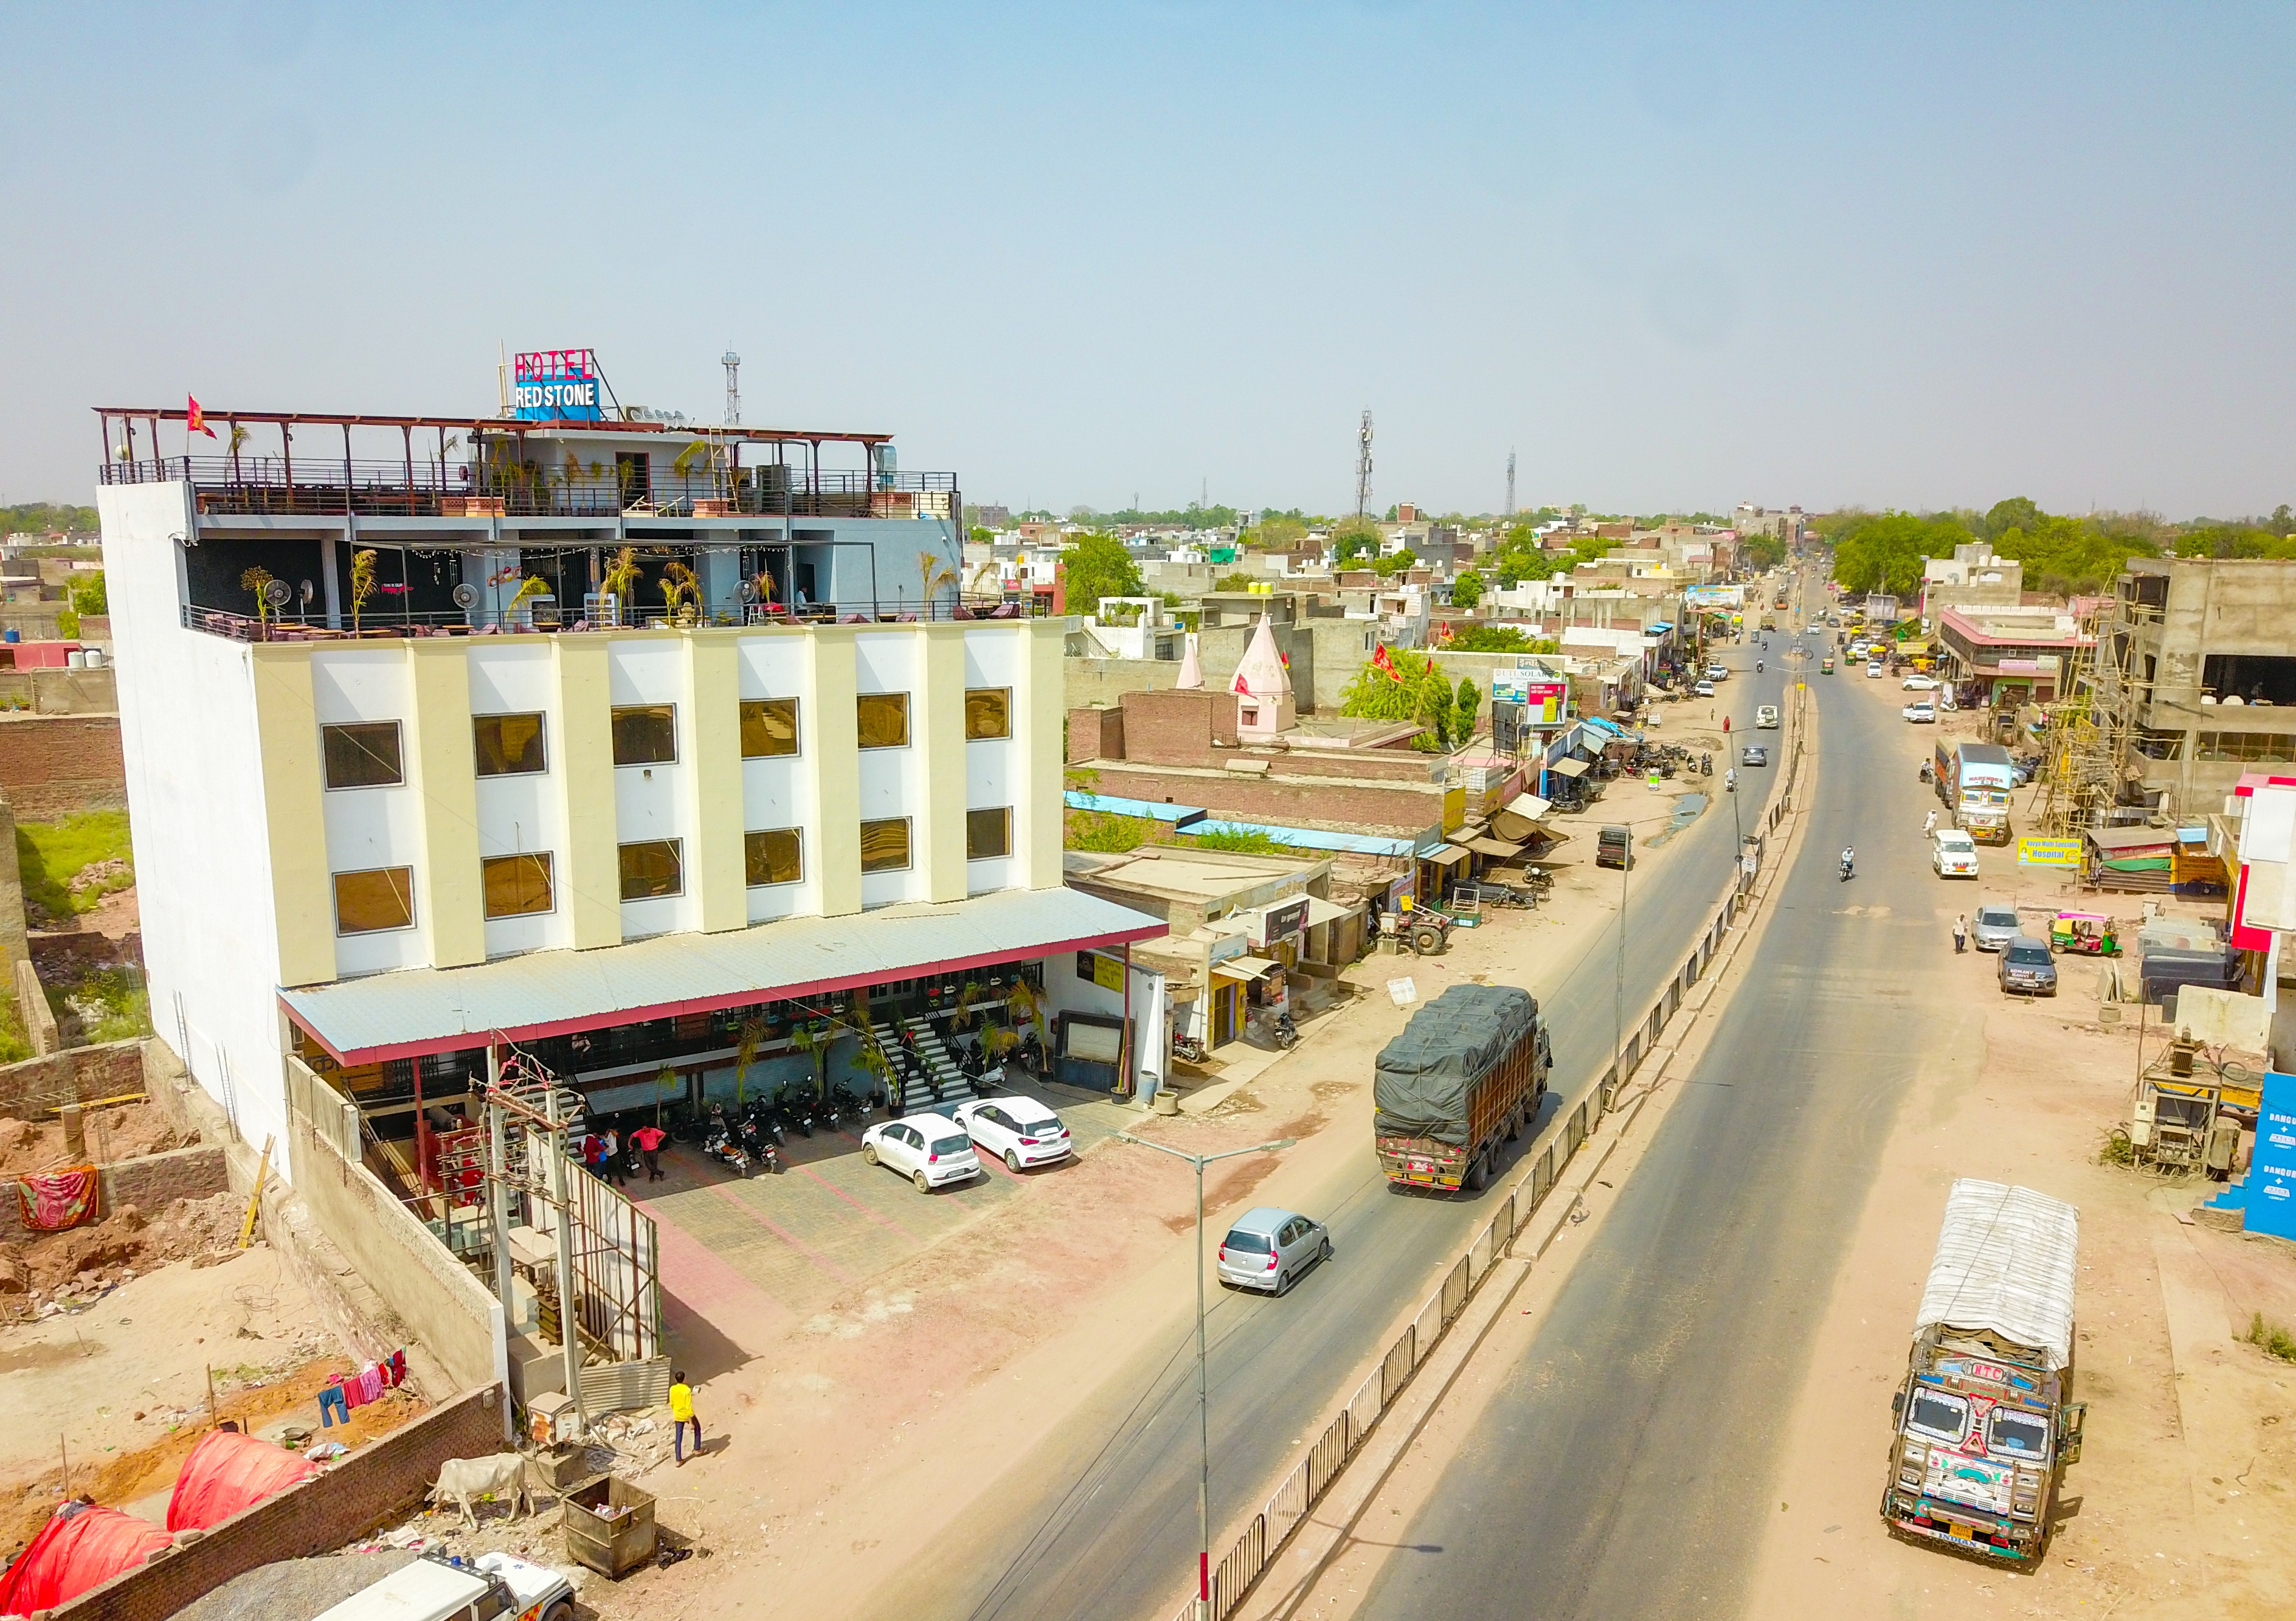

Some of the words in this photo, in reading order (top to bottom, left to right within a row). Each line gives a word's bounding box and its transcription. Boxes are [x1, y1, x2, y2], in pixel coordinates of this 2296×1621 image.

[516, 349, 593, 381] HOTEL
[2033, 849, 2064, 858] Hospital
[1939, 1533, 1977, 1547] INDIAN
